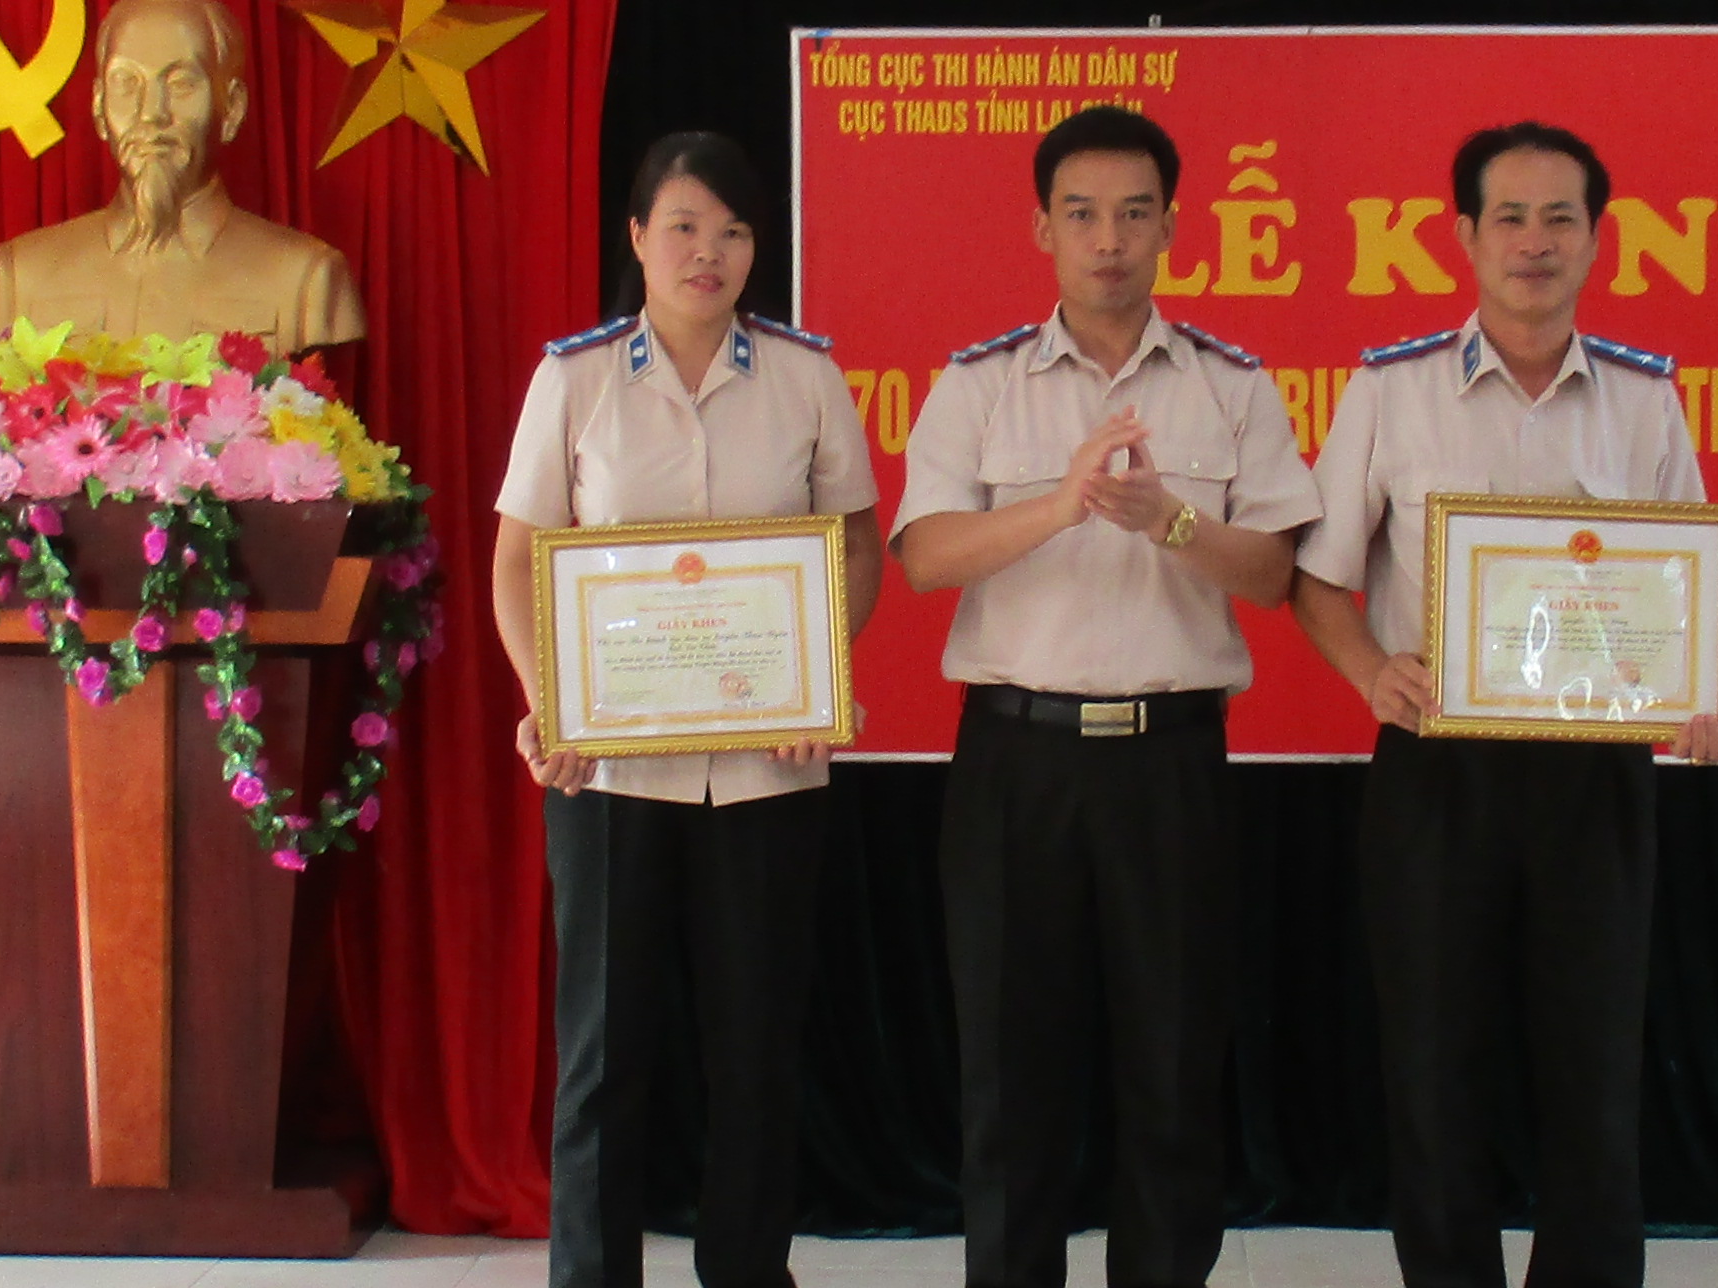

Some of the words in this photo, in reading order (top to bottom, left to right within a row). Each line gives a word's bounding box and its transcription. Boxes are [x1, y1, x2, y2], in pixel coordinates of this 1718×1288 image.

[809, 39, 871, 87] TỔNG
[878, 52, 926, 94] CỤC
[933, 52, 969, 87] THI
[975, 45, 1041, 87] HÀNH
[1047, 45, 1081, 87] ÁN
[1086, 46, 1137, 87] DÂN
[1142, 48, 1179, 94] SỰ
[838, 99, 887, 141] CỤC
[892, 99, 969, 134] THADS
[1347, 196, 1457, 296] K
[843, 367, 911, 455] 70
